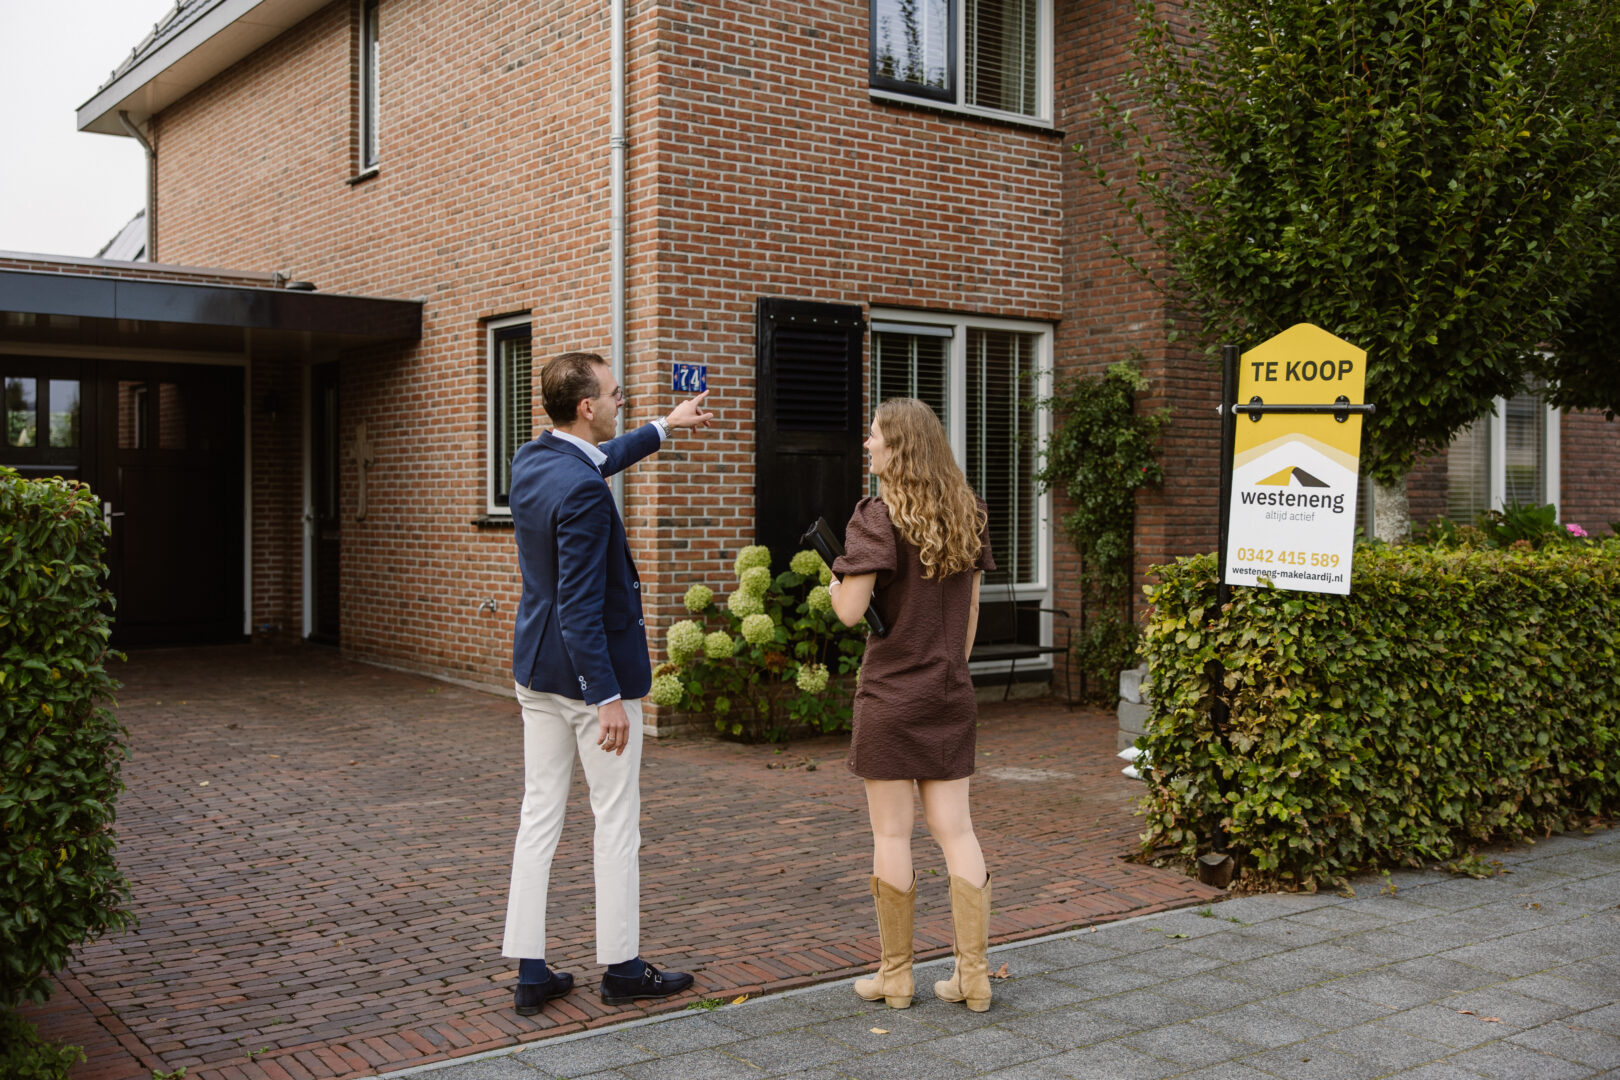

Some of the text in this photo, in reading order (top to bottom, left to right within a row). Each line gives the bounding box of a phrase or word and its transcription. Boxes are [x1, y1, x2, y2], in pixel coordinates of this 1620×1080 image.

[680, 368, 700, 388] 74
[1251, 360, 1353, 382] TE KOOP
[1241, 490, 1344, 514] westeneng
[1265, 511, 1315, 522] altijd actief
[1237, 547, 1340, 568] 0342 415 589
[1232, 567, 1343, 583] westeneng-makelaardij.nl
